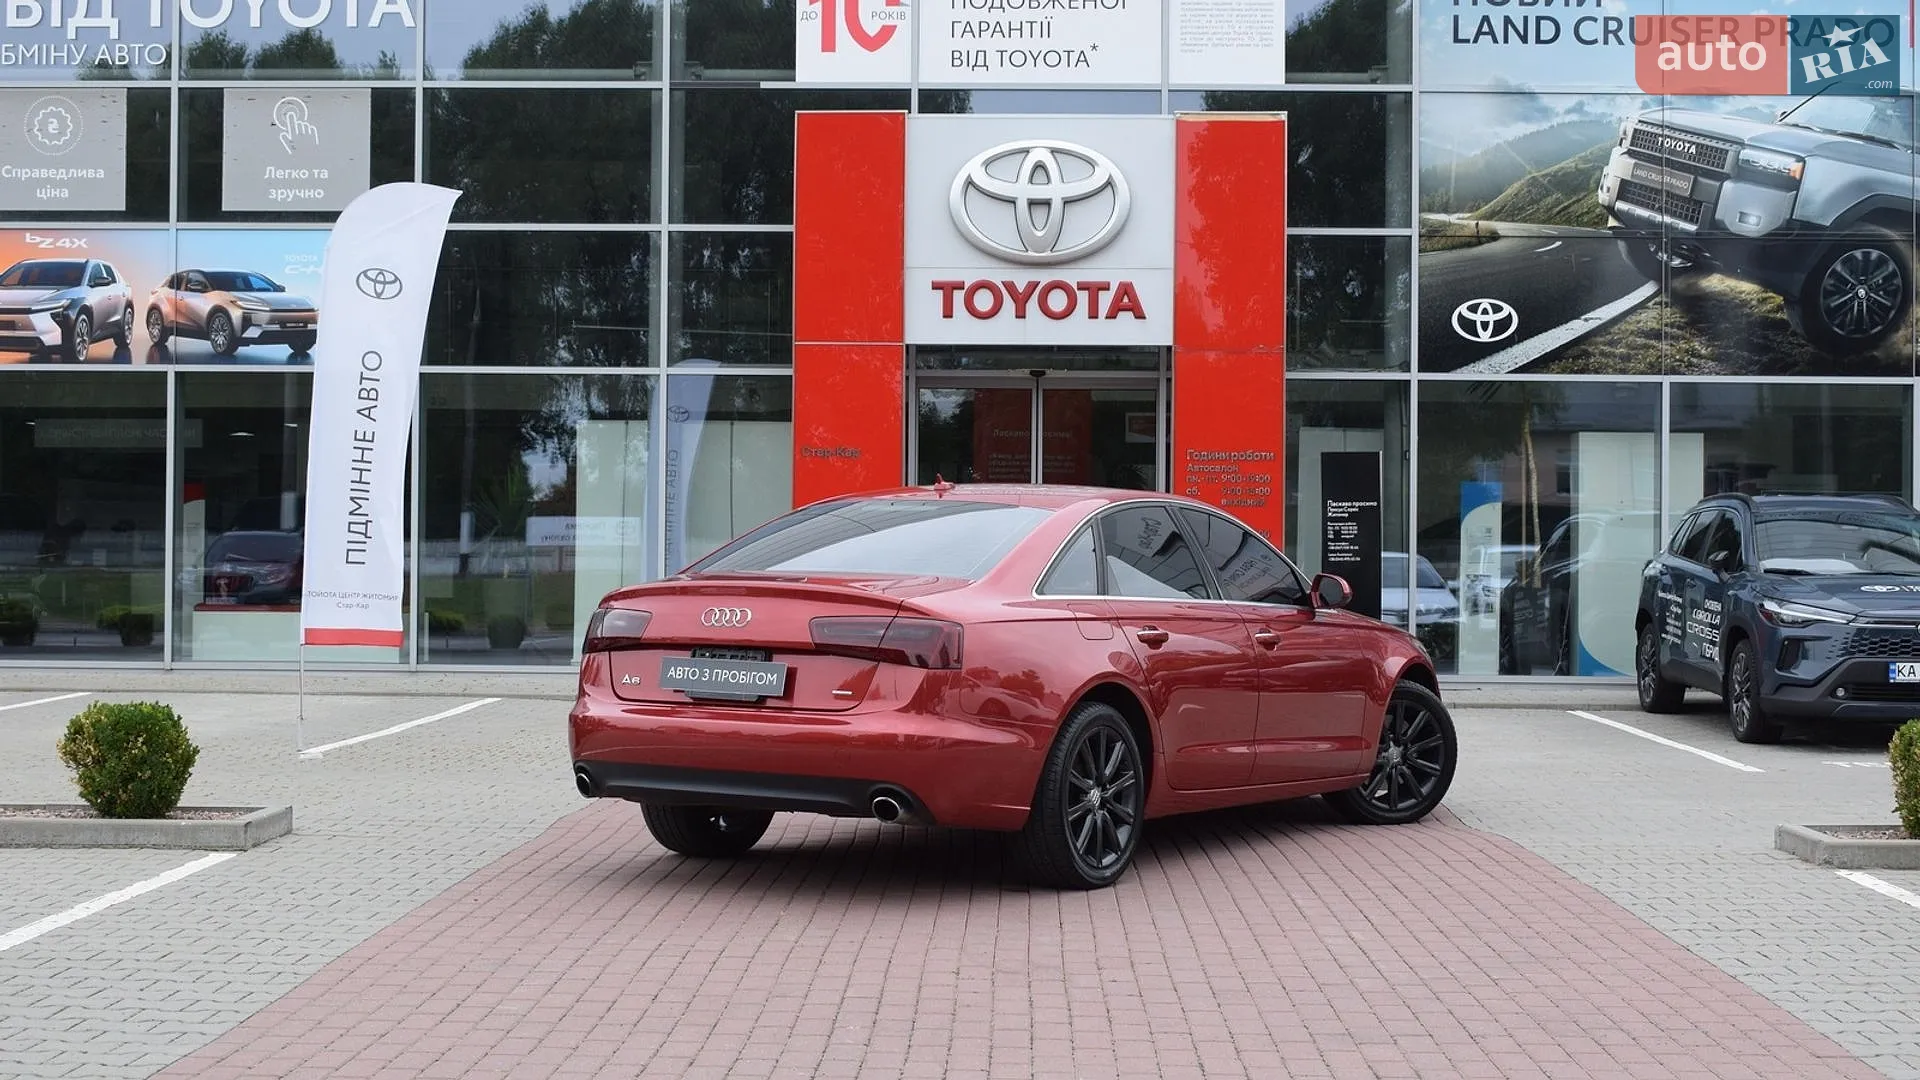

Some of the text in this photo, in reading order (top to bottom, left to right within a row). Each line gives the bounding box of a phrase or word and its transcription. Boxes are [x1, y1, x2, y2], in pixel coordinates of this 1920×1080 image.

[800, 10, 819, 21] ДО
[871, 11, 906, 21] РОКІВ
[951, 15, 1054, 39] ГАРАНТІЇ
[1452, 14, 1562, 45] LAND
[94, 43, 167, 66] АВТО
[951, 50, 989, 71] ВІД
[1658, 136, 1696, 155] TOYOTA
[1, 165, 105, 180] Справедлива
[264, 166, 329, 179] Легко та
[36, 184, 69, 200] ціна
[268, 188, 325, 201] зручно
[931, 279, 1147, 320] TOYOTA
[345, 350, 383, 565] ПІДМІННЕ АВТО
[1186, 449, 1275, 462] Години роботи
[1186, 463, 1239, 472] Автосалон
[1687, 621, 1720, 642] CROSS
[621, 673, 641, 685] A6
[667, 666, 700, 681] АВТО
[712, 670, 778, 686] ПРОБІГОМ
[1897, 664, 1917, 678] KA
